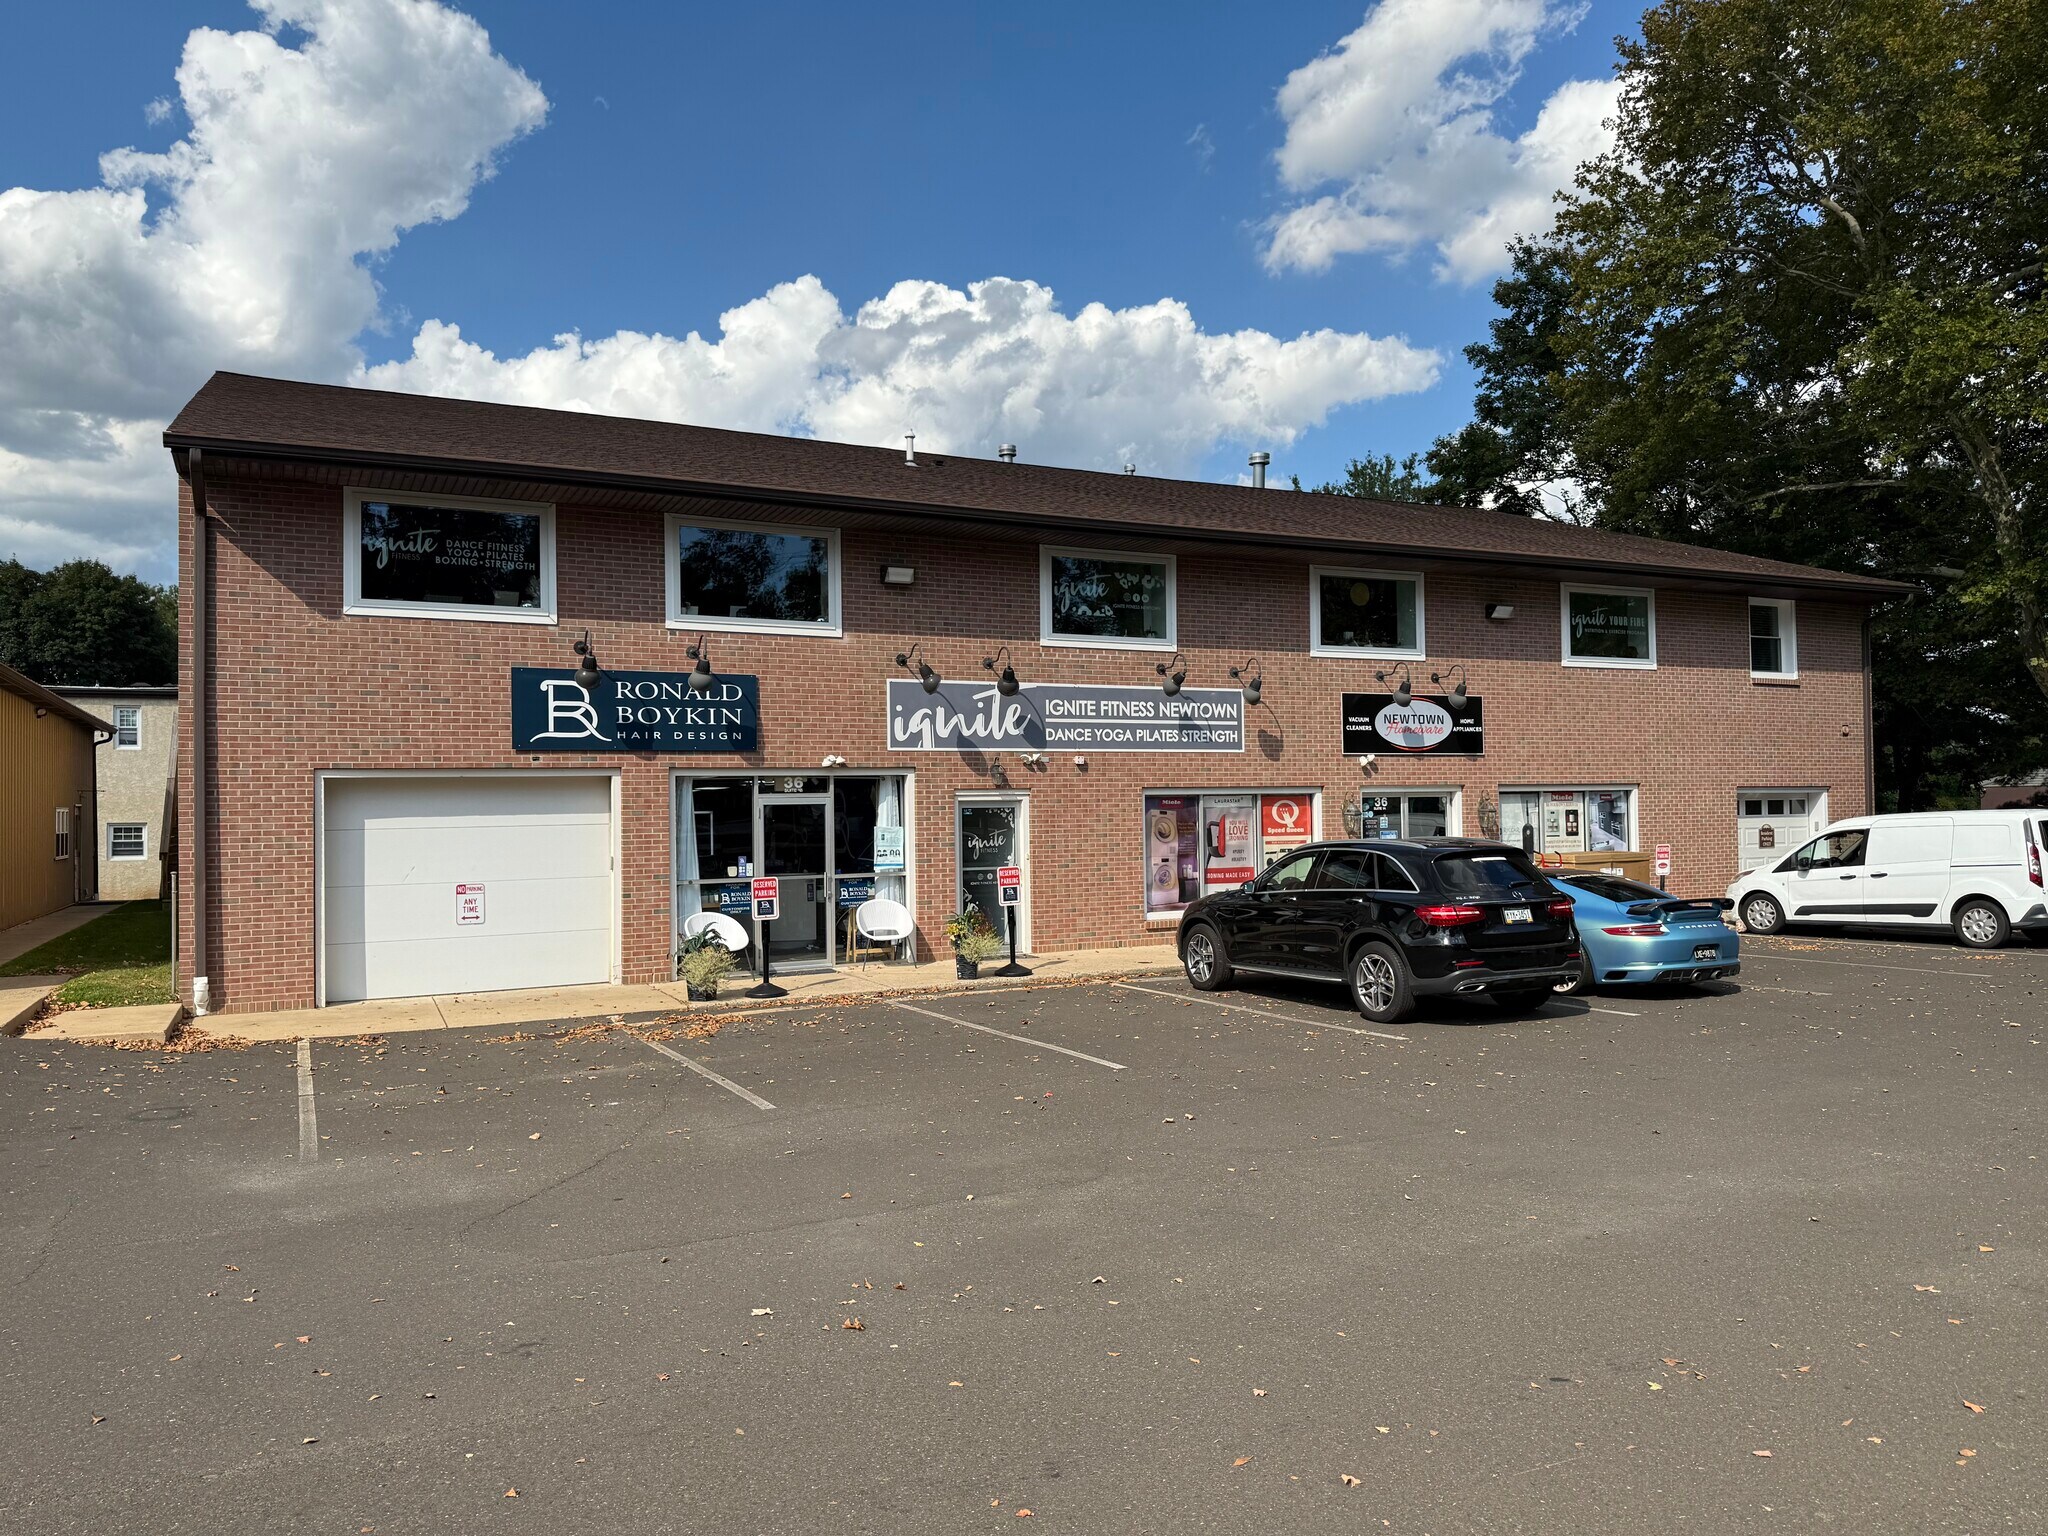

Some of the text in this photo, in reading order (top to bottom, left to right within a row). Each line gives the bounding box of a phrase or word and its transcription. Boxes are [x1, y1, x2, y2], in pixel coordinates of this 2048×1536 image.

[367, 527, 441, 569] ignite
[446, 540, 525, 553] DANCE FITNESS
[391, 552, 421, 561] FITNESS
[1054, 569, 1112, 613] ignite
[1571, 606, 1646, 638] ignite YOUR FIRE
[614, 680, 744, 701] RONALD
[1045, 699, 1238, 719] IGNITE FITNESS NEWTOWN
[615, 706, 744, 726] BOYKIN
[893, 683, 1037, 749] ignite
[1383, 713, 1445, 725] NEWTOWN
[1045, 728, 1238, 743] DANCE YOGA PILATES STRENGTH
[1384, 722, 1445, 736] Homeware
[617, 731, 743, 741] HAIR DESIGN
[783, 776, 804, 789] 36
[1374, 797, 1388, 807] 36
[1228, 825, 1249, 835] LOVE
[967, 828, 1008, 860] ignite
[1001, 869, 1019, 877] RESERVED
[1000, 877, 1019, 885] PARKING
[457, 886, 466, 894] NO
